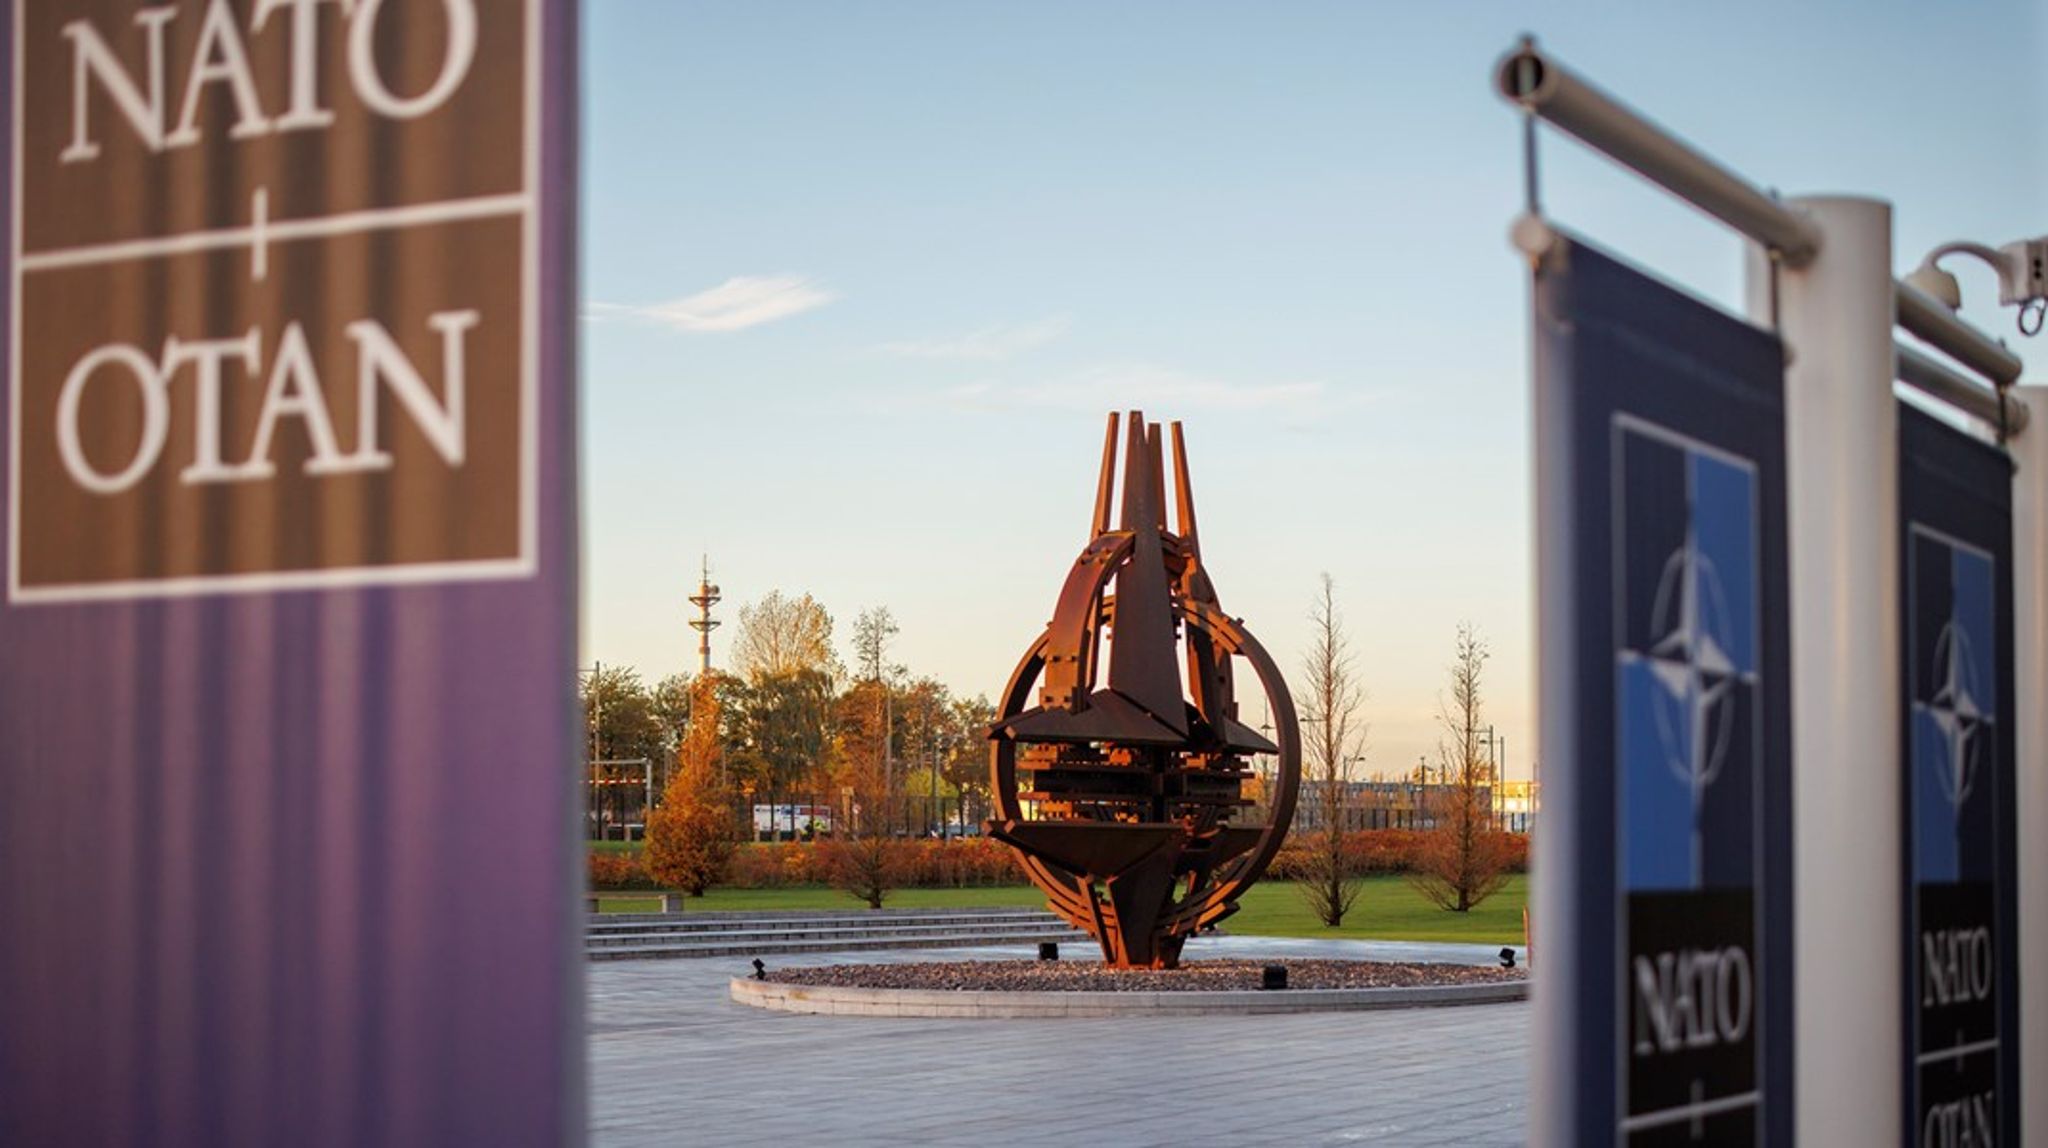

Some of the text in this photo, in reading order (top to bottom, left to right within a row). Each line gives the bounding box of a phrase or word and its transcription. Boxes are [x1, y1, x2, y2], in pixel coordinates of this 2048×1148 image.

[60, 0, 478, 162] NATO
[56, 308, 480, 493] OTAN
[1634, 945, 1751, 1055] NATO
[1922, 926, 1991, 1007] NATO
